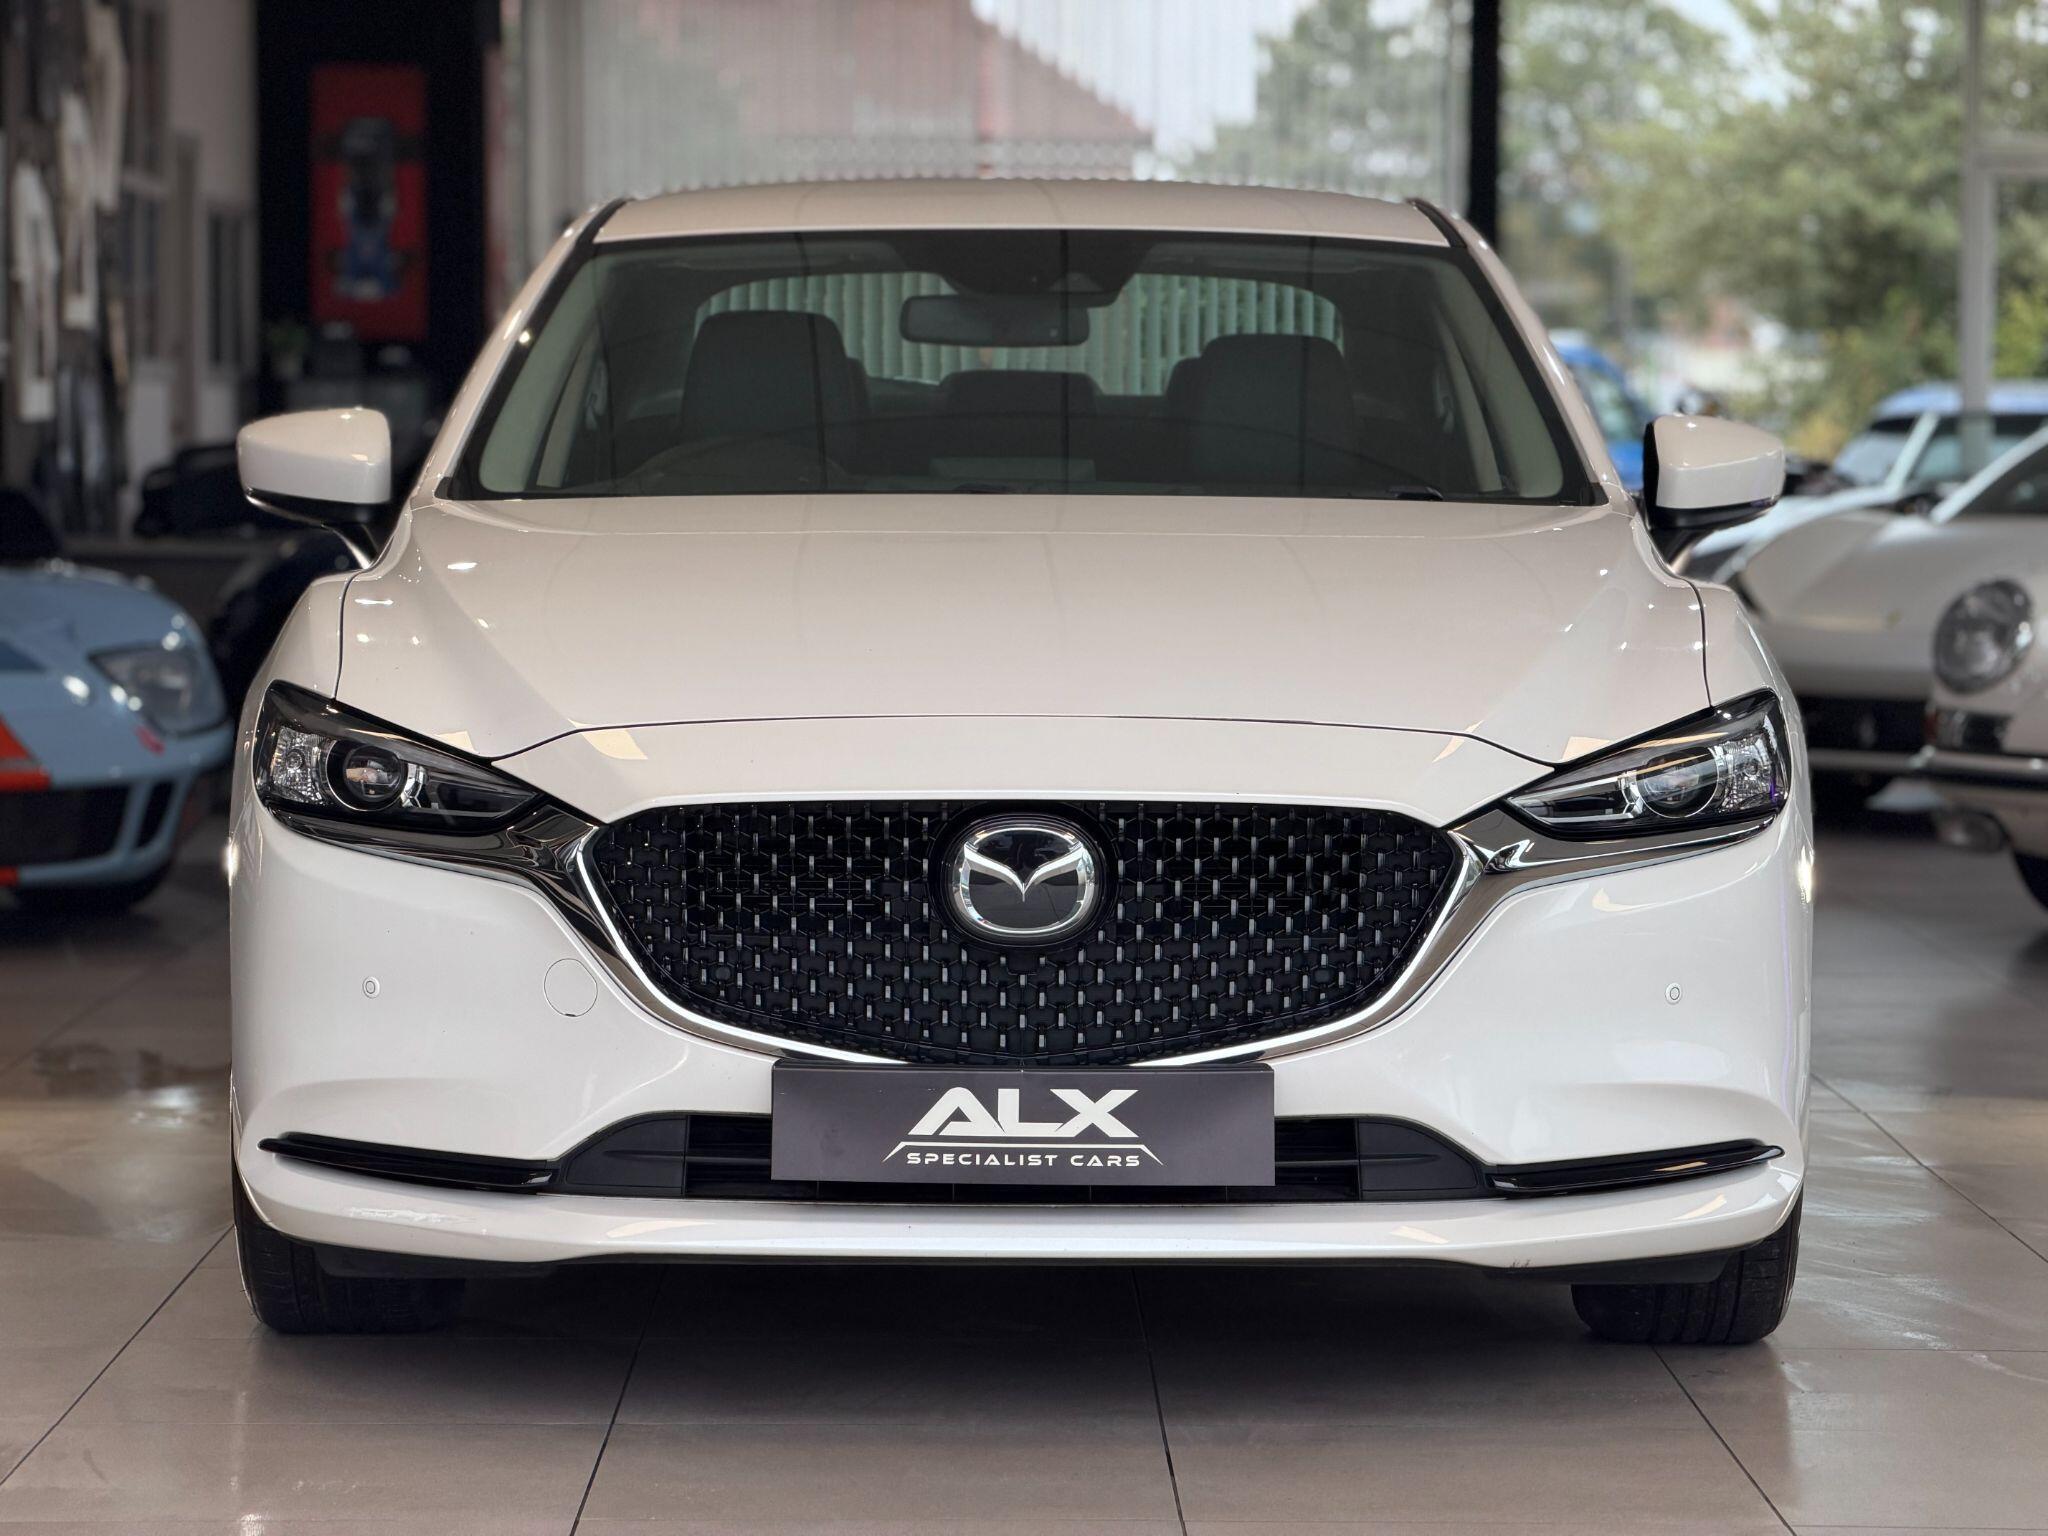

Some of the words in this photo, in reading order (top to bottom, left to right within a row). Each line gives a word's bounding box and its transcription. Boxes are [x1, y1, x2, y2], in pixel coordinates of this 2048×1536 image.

[908, 1086, 1140, 1138] ALX
[907, 1152, 1058, 1167] SPECIALIST
[1070, 1154, 1140, 1167] CARS
